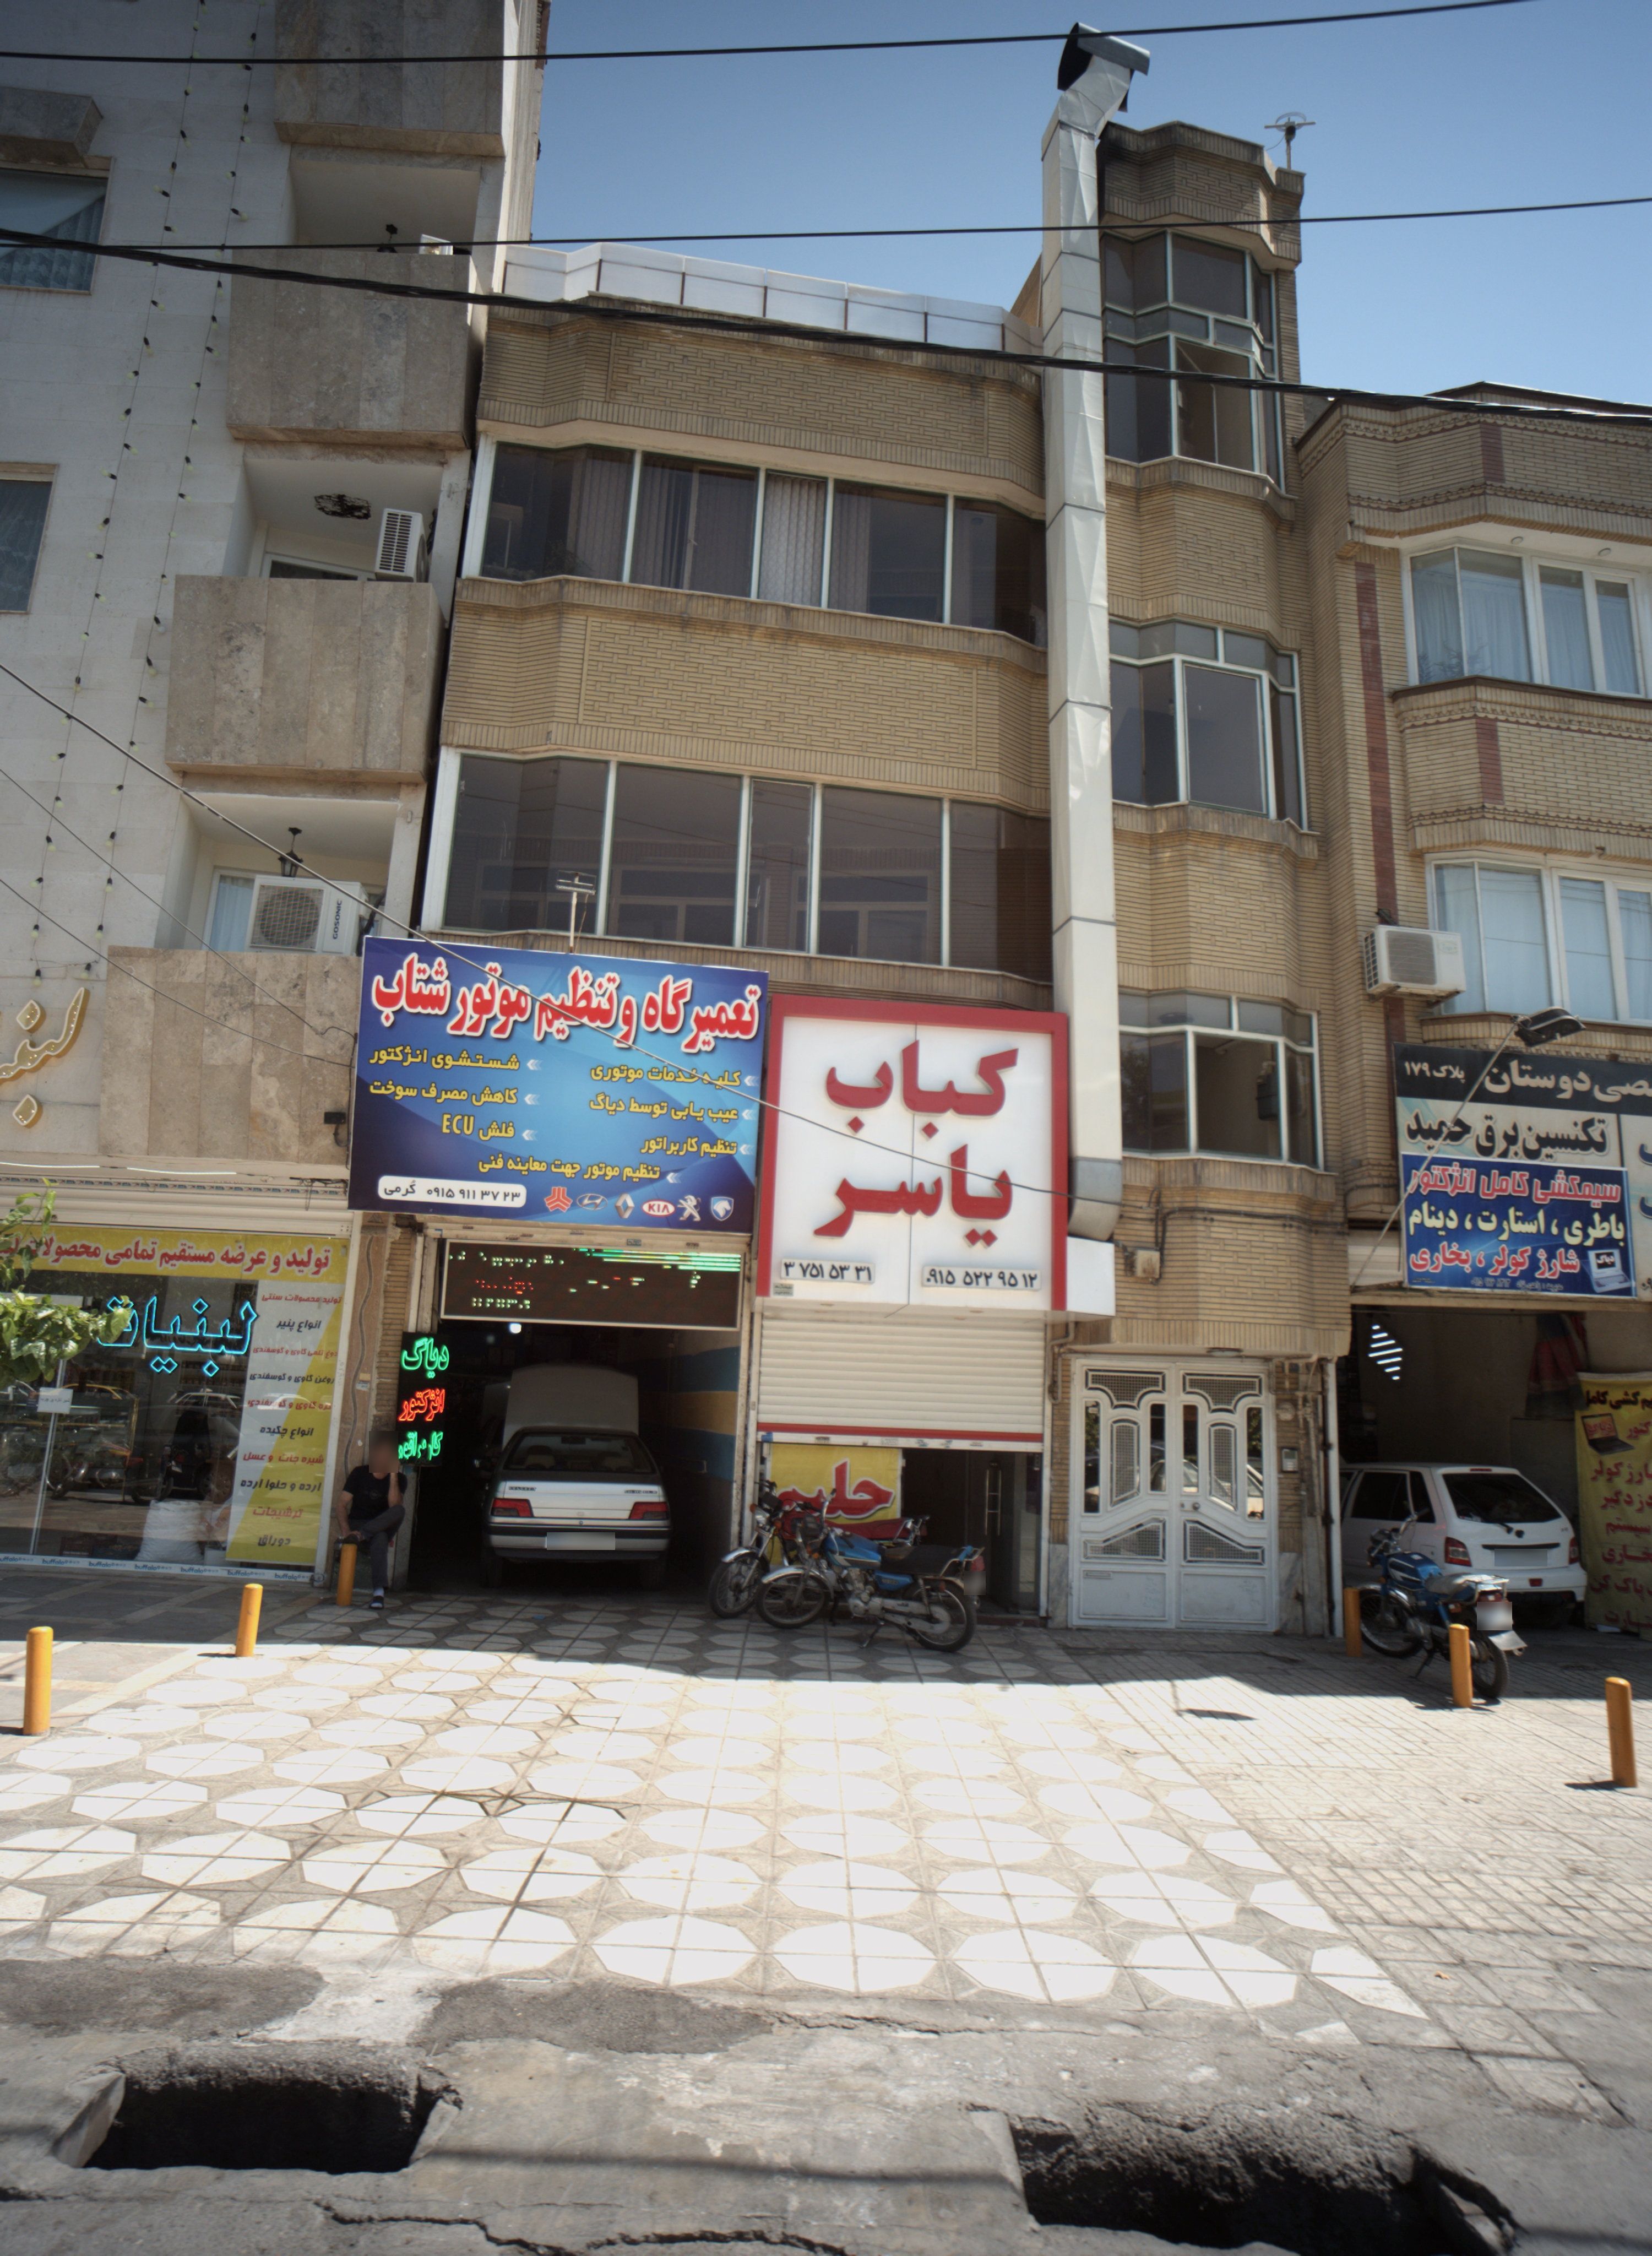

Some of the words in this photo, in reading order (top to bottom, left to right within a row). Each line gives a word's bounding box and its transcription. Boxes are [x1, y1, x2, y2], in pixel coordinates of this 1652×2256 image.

[333, 899, 342, 940] GOSONIC
[373, 953, 450, 1026] شتاب
[447, 963, 531, 1037] موتور
[535, 966, 620, 1041] تنظیم
[614, 994, 638, 1049] و
[369, 1045, 428, 1066] انژکتور
[431, 1050, 520, 1070] شستشوی
[591, 1064, 644, 1083] موتوری
[646, 1066, 700, 1083] خدمات
[1405, 1061, 1431, 1077] ۱۷۹
[1433, 1065, 1466, 1083] پلاک
[702, 1070, 741, 1089] کلیه
[827, 1040, 1019, 1139] کباب
[1485, 1060, 1591, 1099] دوستان
[369, 1080, 418, 1100] سوخت
[422, 1082, 469, 1103] مصرف
[472, 1086, 519, 1106] کاهش
[590, 1092, 626, 1115] دیاگ
[629, 1097, 668, 1119] توسط
[670, 1102, 705, 1122] یابی
[442, 1113, 475, 1135] ECU
[707, 1108, 739, 1124] عیب
[478, 1120, 515, 1141] فلش
[1406, 1111, 1472, 1151] حمید
[1476, 1114, 1519, 1158] برق
[1521, 1117, 1607, 1160] تکنسین
[700, 1139, 737, 1158] تنظیم
[478, 1152, 504, 1172] فنی
[507, 1156, 547, 1175] معاینه
[551, 1159, 582, 1178] جهت
[583, 1162, 621, 1180] موتور
[622, 1163, 661, 1182] تنظیم
[1407, 1162, 1477, 1197] انژکتور
[426, 1187, 455, 1198] ۰۹۱۵
[459, 1188, 476, 1200] ۹۱۱
[480, 1190, 499, 1201] ۳۷
[503, 1191, 521, 1202] ۲۳
[1479, 1170, 1529, 1199] کامل
[1533, 1169, 1621, 1208] سیمکشی
[814, 1144, 1012, 1246] یاسر
[648, 1203, 671, 1214] KIA
[1409, 1201, 1459, 1236] دینام
[1477, 1206, 1545, 1241] استارت
[1564, 1212, 1624, 1247] باطری
[105, 1239, 157, 1265] تمامی
[160, 1241, 215, 1268] مستقیم
[221, 1245, 267, 1272] عرضه
[286, 1247, 331, 1276] تولید
[1410, 1241, 1472, 1273] بخاری
[1488, 1244, 1531, 1276] کولر
[270, 1254, 281, 1273] و
[800, 1262, 824, 1279] ۷۵۱
[829, 1265, 849, 1280] ۵۳
[855, 1266, 872, 1281] ۳۱
[1535, 1248, 1580, 1279] شارژ
[998, 1271, 1018, 1287] ۹۵
[1022, 1273, 1037, 1288] ۱۲
[262, 1293, 282, 1302] سنتی
[285, 1294, 320, 1303] محصولات
[322, 1295, 343, 1305] تولید
[276, 1319, 296, 1332] پنیر
[297, 1320, 322, 1333] انواع
[96, 1295, 257, 1377] لبنیات
[401, 1337, 450, 1379] دیاگ
[314, 1375, 335, 1384] روغن
[399, 1389, 445, 1421] انژکتور
[259, 1426, 287, 1439] چکیده
[290, 1427, 314, 1439] انواع
[243, 1452, 266, 1461] عسل
[268, 1455, 274, 1463] و
[278, 1454, 299, 1465] جات
[301, 1454, 324, 1466] شیره
[241, 1479, 263, 1489] ارده
[265, 1479, 287, 1490] حلوا
[290, 1483, 296, 1492] و
[299, 1482, 322, 1492] ارده
[253, 1506, 303, 1519] ترشیجات
[257, 1534, 291, 1547] دوراق
[181, 1565, 204, 1574] buffalo
